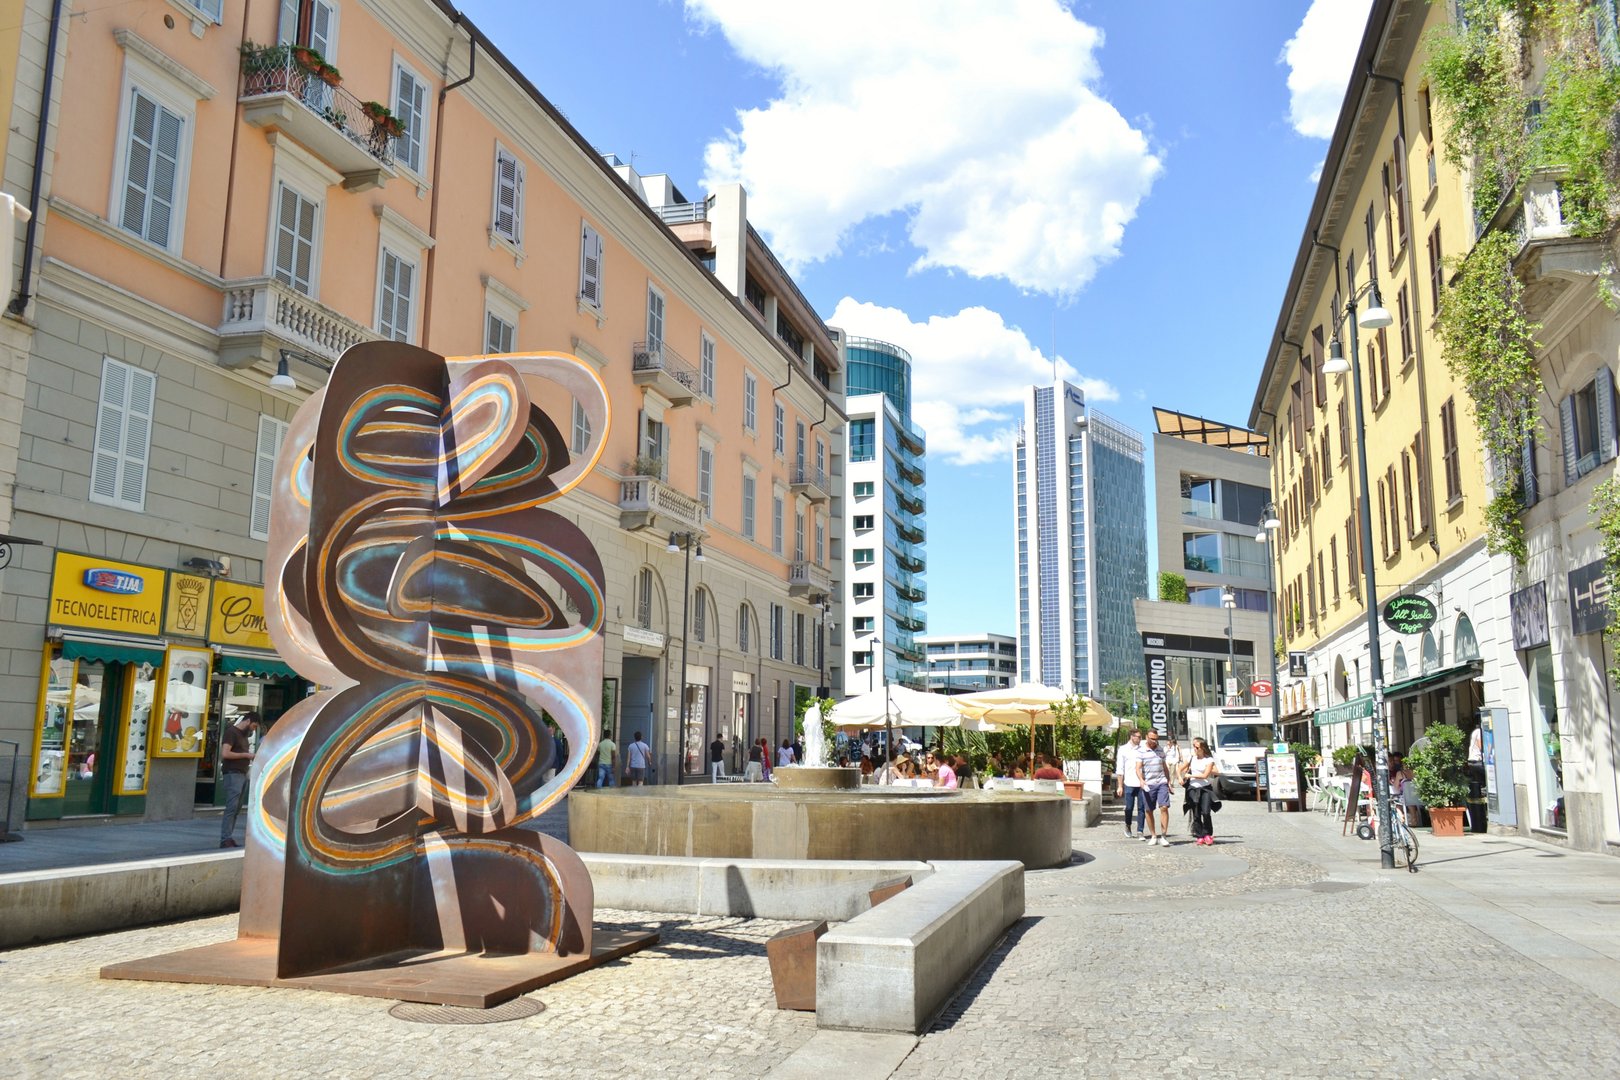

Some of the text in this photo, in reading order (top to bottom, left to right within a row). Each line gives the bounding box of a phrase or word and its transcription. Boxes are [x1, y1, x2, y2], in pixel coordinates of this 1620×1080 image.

[115, 576, 140, 593] TIM
[55, 598, 157, 626] TECNOELETTRICA
[1389, 598, 1429, 611] Ristorante
[1408, 609, 1433, 620] Isola
[1399, 623, 1423, 634] Pizza
[1151, 659, 1167, 736] MOSCHINO
